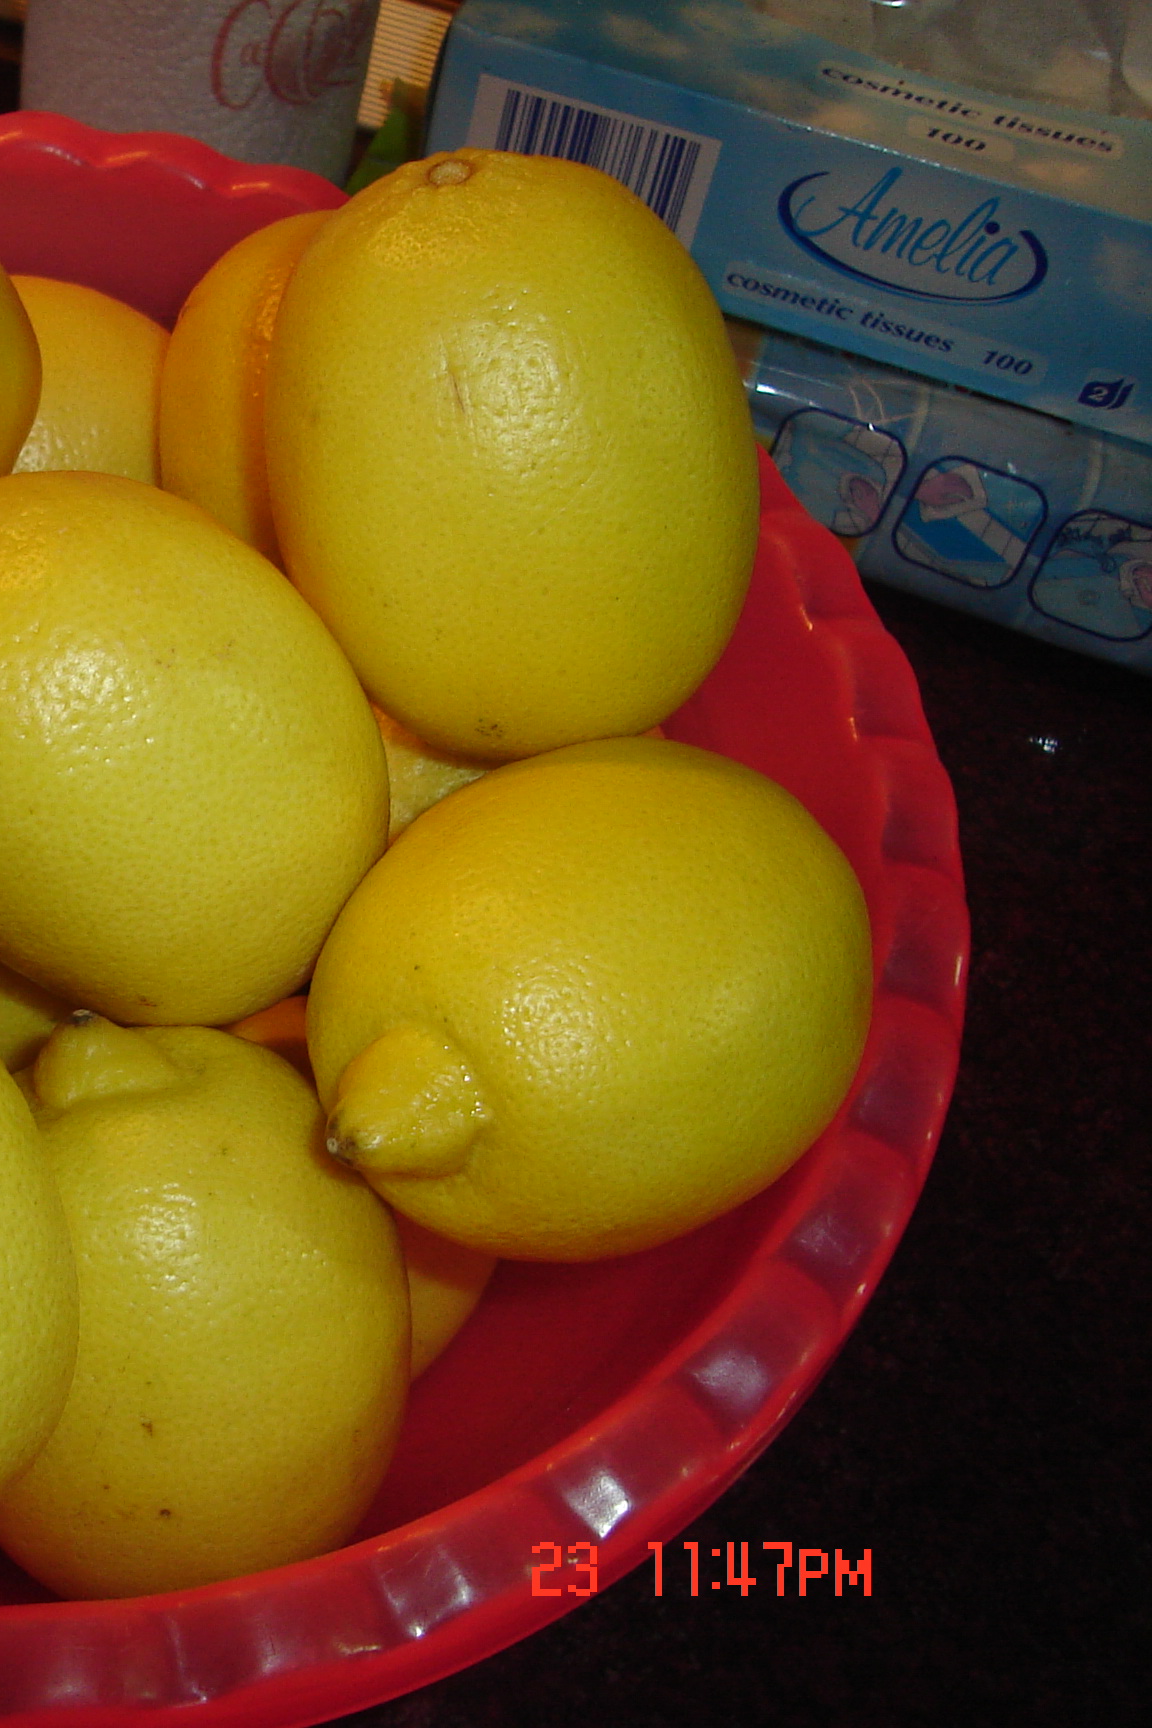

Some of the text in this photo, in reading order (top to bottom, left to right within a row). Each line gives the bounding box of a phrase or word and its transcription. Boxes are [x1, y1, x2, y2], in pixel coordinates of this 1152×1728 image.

[821, 66, 1113, 154] cosmetic tissues
[927, 126, 986, 152] 100
[793, 167, 1020, 286] Amelia
[726, 271, 1034, 376] cosmetic tissues 100
